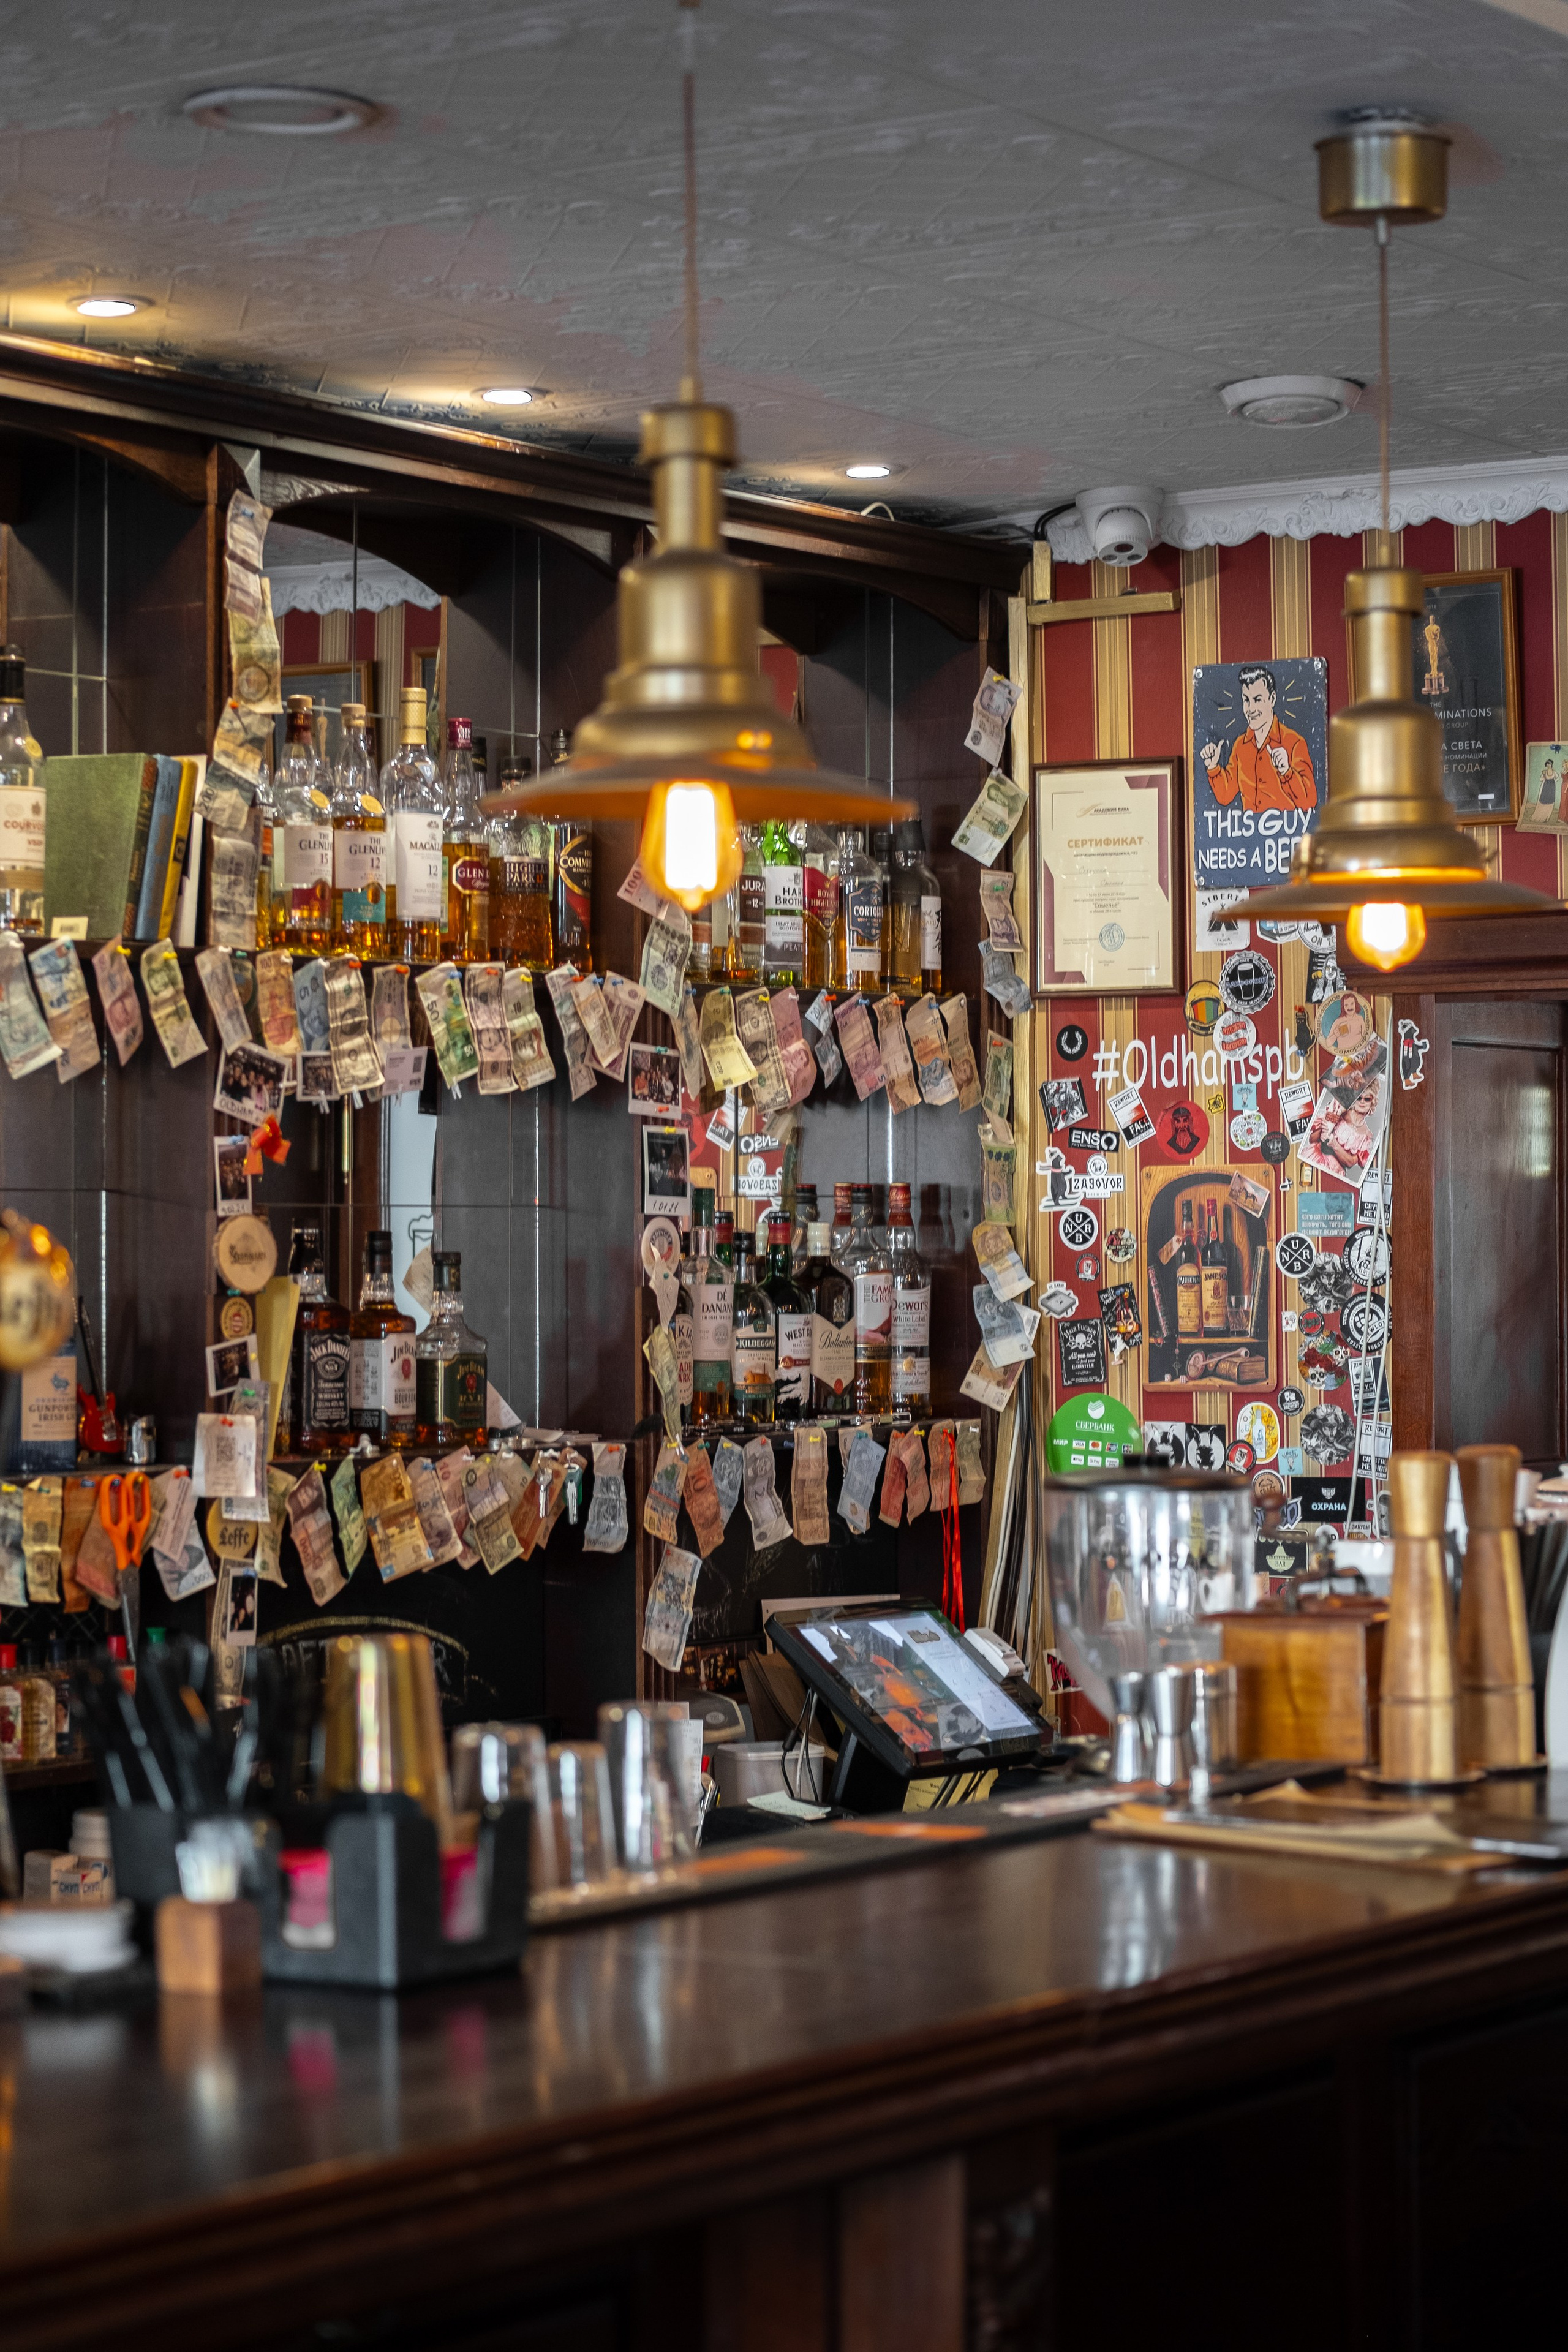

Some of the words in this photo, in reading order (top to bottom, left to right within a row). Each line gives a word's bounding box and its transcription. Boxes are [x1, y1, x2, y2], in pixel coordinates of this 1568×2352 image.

[1434, 707, 1491, 720] MINATIONS
[1451, 741, 1483, 751] СВЕТА
[1203, 809, 1255, 839] THIS
[1257, 807, 1313, 837] GUY
[1067, 835, 1144, 849] СЕРТИФИКАТ
[320, 853, 328, 865] 15
[1198, 847, 1247, 870] NEEDS
[1250, 846, 1262, 868] A
[1265, 836, 1303, 874] BE
[370, 857, 380, 869] 12
[428, 864, 438, 876] 12
[458, 867, 484, 879] GLEN
[507, 872, 535, 883] PARK
[741, 879, 766, 892] JURA
[817, 889, 835, 898] ROYAL
[752, 897, 758, 908] 12
[1311, 935, 1323, 946] ON
[1284, 1086, 1306, 1101] REWORT
[1114, 1091, 1134, 1109] REWORT
[1366, 1171, 1391, 1183] REWT
[717, 1288, 728, 1302] DÉ
[893, 1314, 911, 1323] White
[911, 1314, 927, 1323] Label
[785, 1327, 805, 1341] WEST
[1063, 1325, 1077, 1339] HAIR
[1077, 1322, 1097, 1336] FUCKER
[391, 1346, 404, 1363] JIM
[1068, 1351, 1077, 1360] All
[1077, 1352, 1086, 1361] you
[1086, 1350, 1096, 1359] need
[457, 1365, 469, 1380] JIM
[1354, 1382, 1374, 1392] CYO
[1076, 1420, 1115, 1432] СБЕРБАНК
[1365, 1424, 1389, 1436] REORT
[1311, 1502, 1347, 1511] ОХРАНА
[219, 1526, 250, 1550] Leffe
